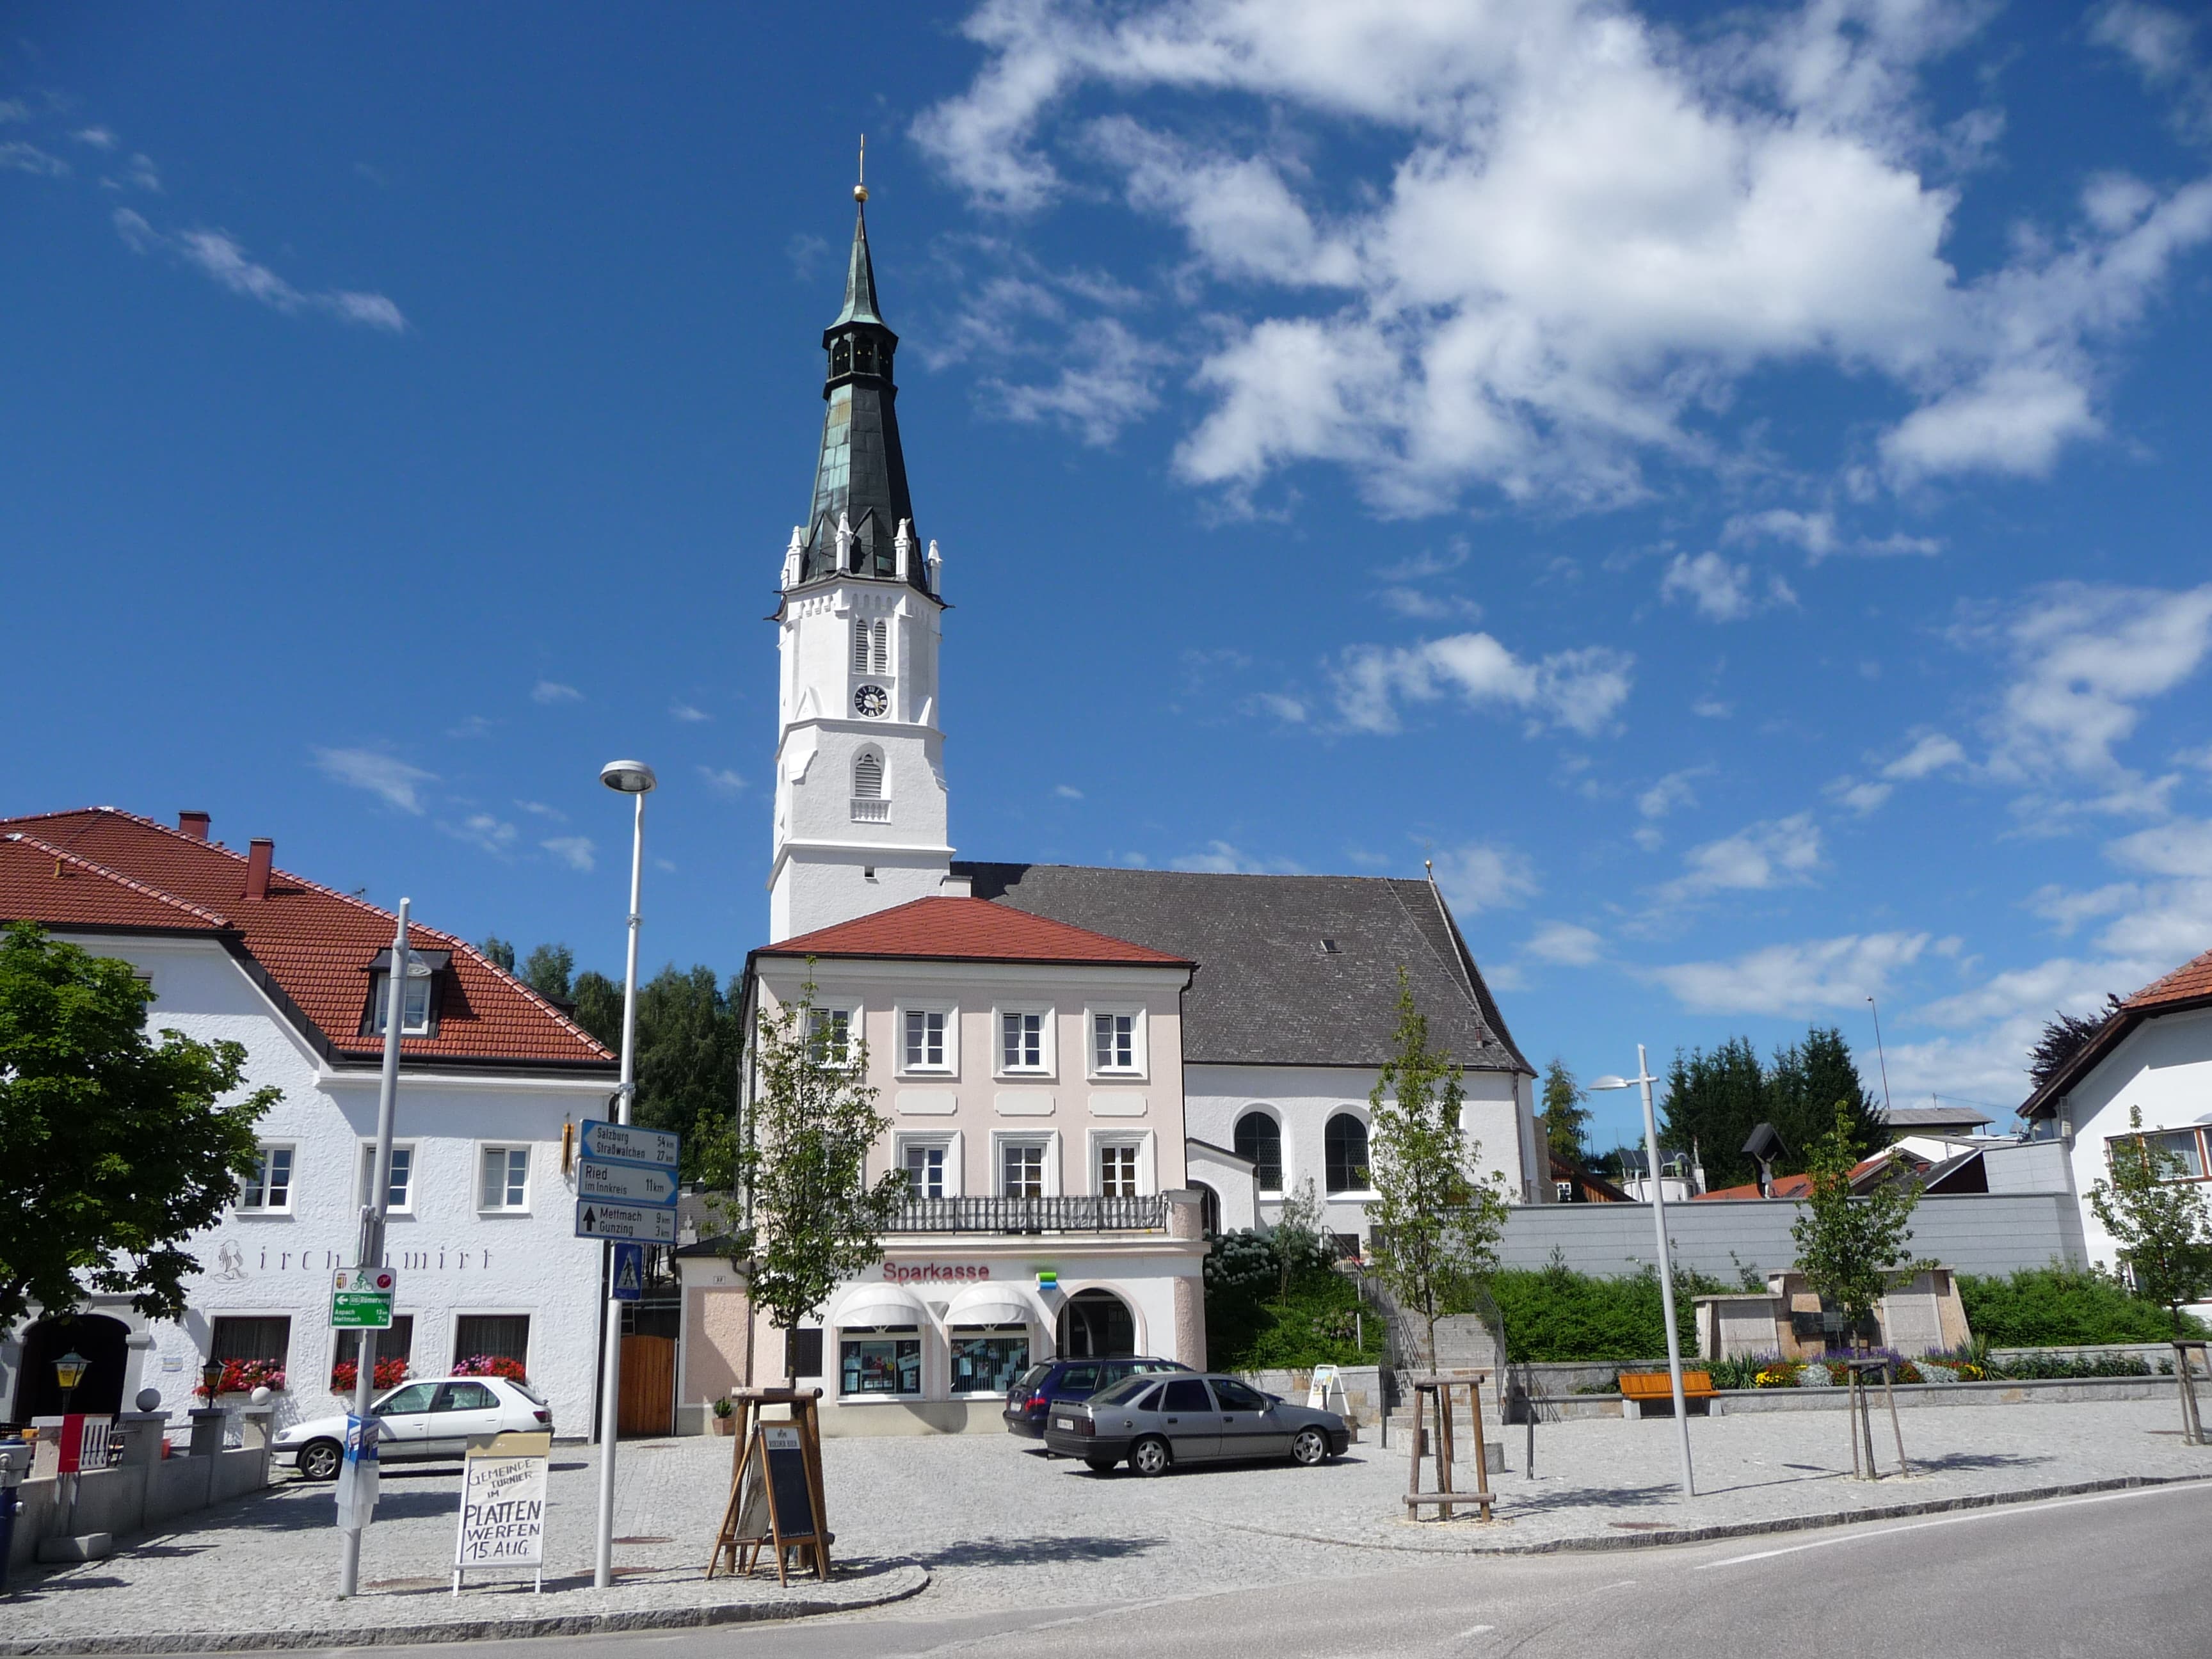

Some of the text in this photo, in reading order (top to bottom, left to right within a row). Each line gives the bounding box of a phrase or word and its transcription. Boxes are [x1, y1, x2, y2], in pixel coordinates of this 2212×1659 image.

[597, 1127, 629, 1145] Salzburg
[657, 1135, 666, 1147] 54
[597, 1142, 645, 1158] Straßwalchen
[657, 1150, 665, 1161] 27
[585, 1182, 627, 1195] im Innkreis
[586, 1166, 664, 1193] Ried 11 km
[600, 1207, 642, 1221] Mettmach
[657, 1212, 661, 1223] 9
[600, 1221, 634, 1237] Gunzing
[655, 1226, 661, 1237] 3
[210, 1239, 492, 1284] Kirchwirt
[883, 1262, 989, 1283] Sparkasse
[492, 1471, 533, 1488] TURNIER
[487, 1490, 499, 1498] IM
[463, 1500, 541, 1529] PLATTEN
[467, 1523, 540, 1541] WERFEN
